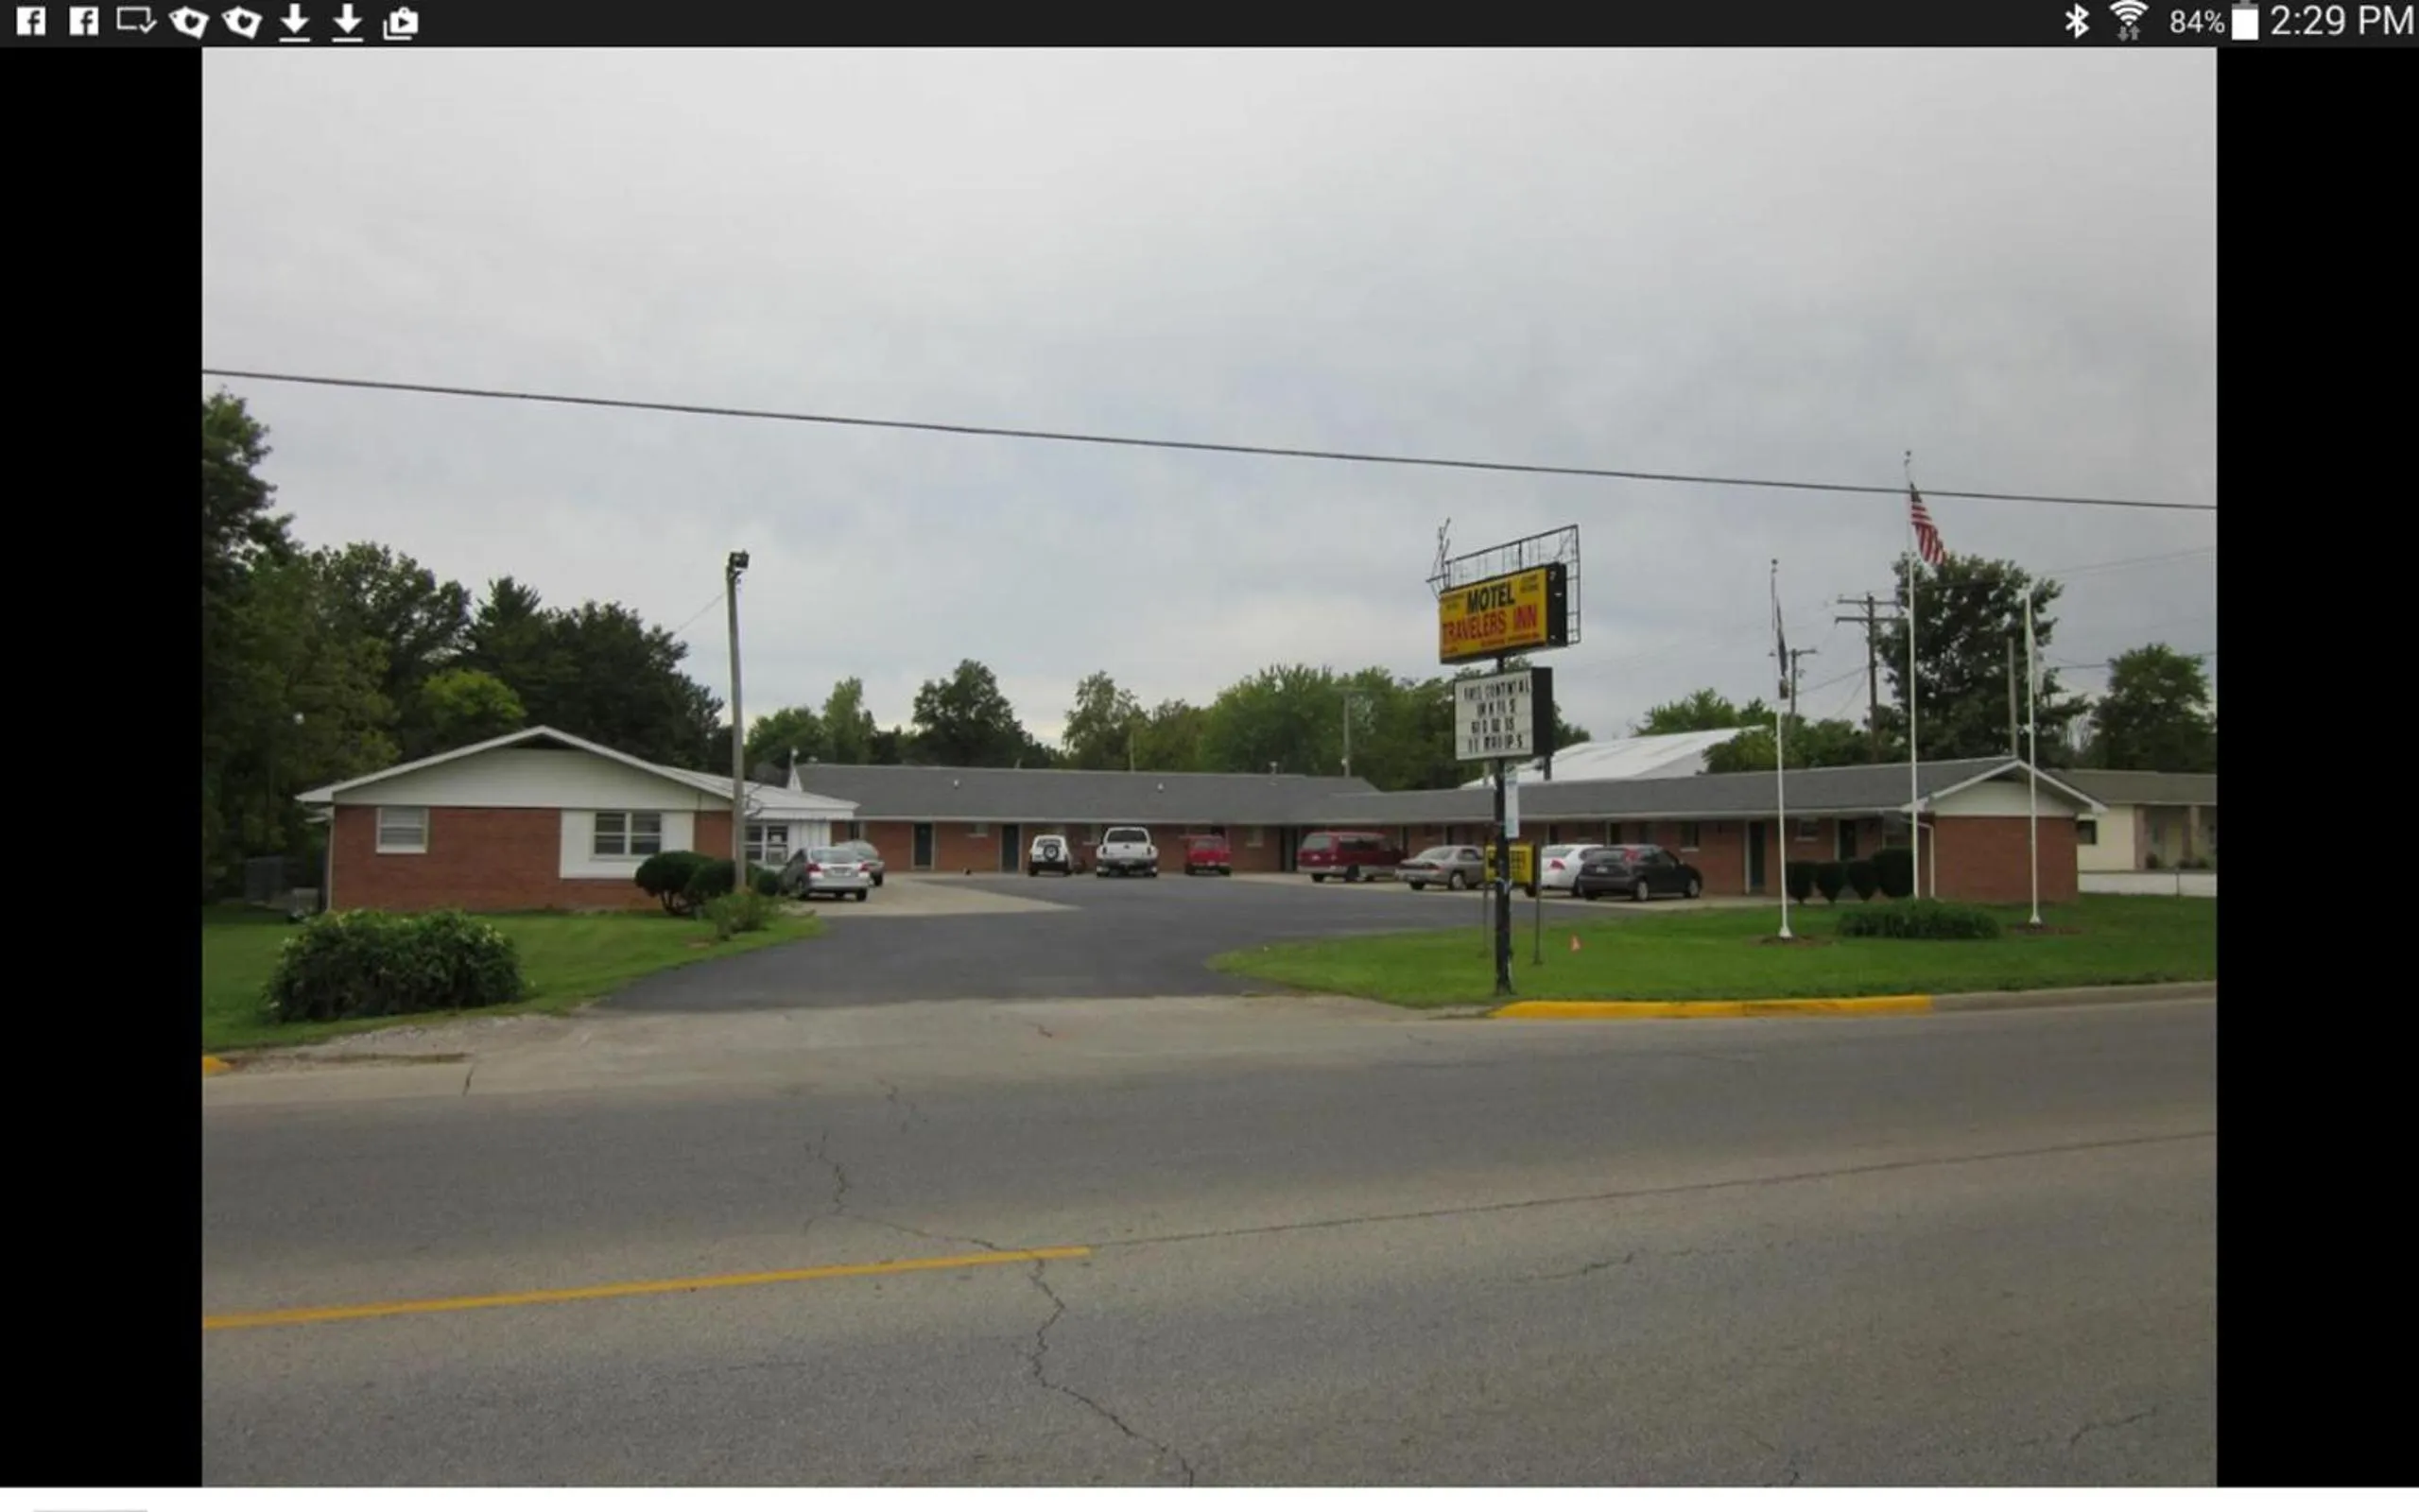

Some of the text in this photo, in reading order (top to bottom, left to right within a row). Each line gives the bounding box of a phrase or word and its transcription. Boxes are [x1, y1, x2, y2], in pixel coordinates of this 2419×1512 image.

[1468, 581, 1515, 612] MOTEL
[1443, 604, 1538, 643] TRAVELERS INN
